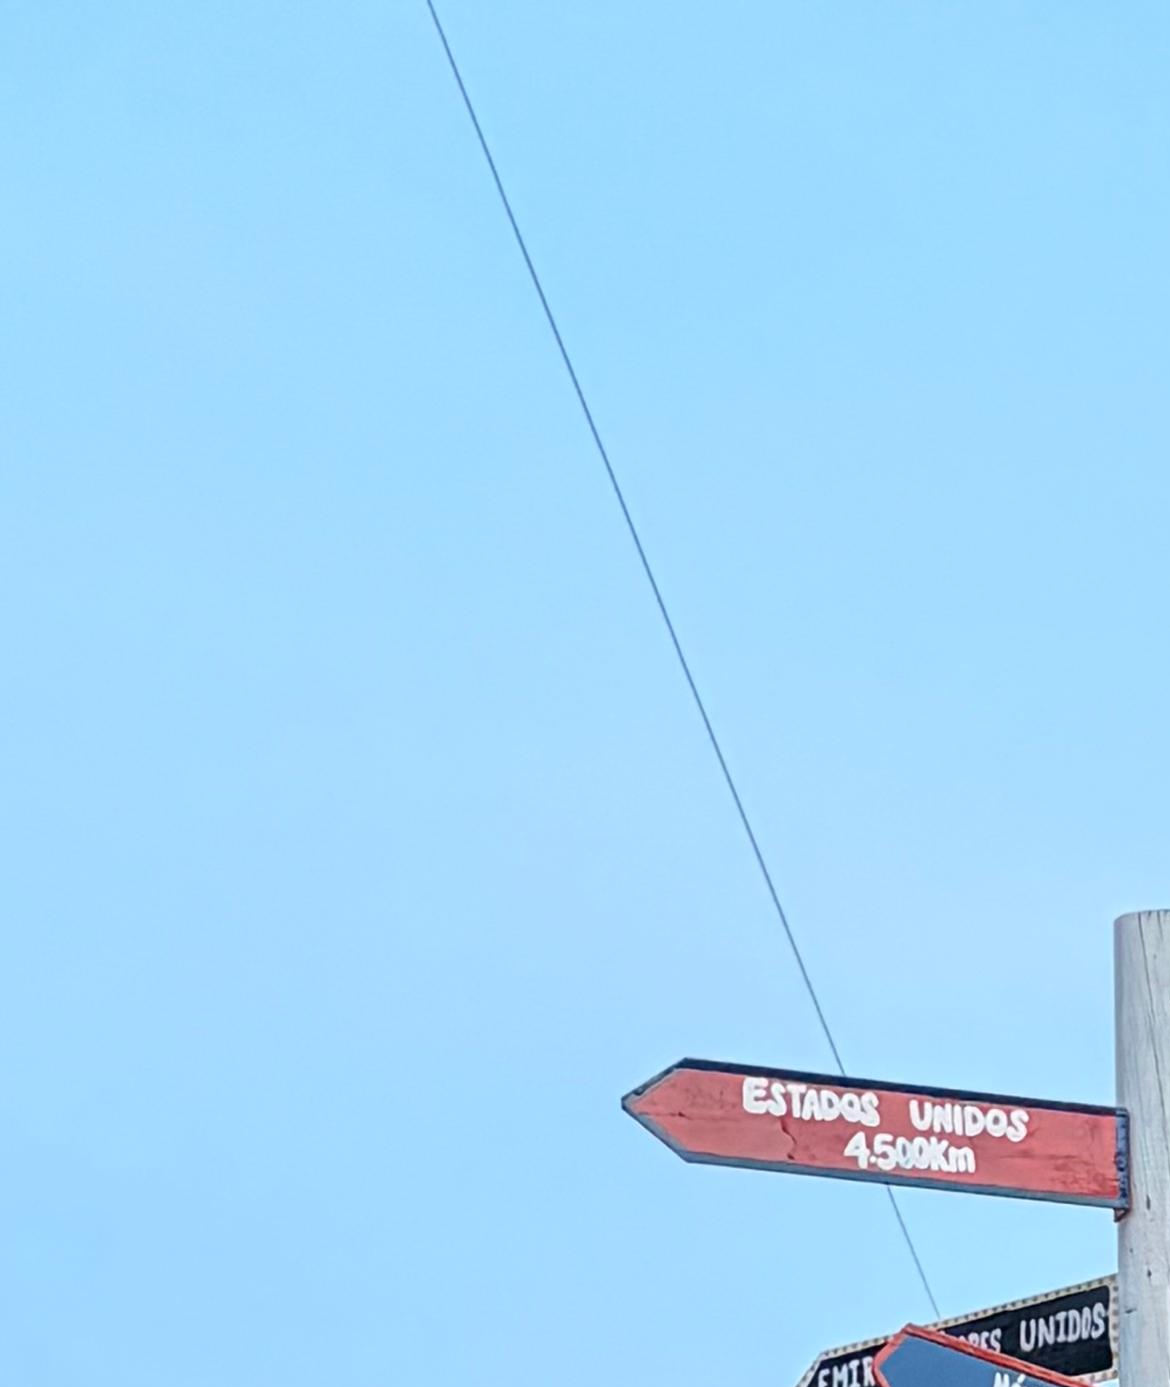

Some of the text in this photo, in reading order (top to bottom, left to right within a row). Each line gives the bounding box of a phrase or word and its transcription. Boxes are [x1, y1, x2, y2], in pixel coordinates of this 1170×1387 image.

[742, 1076, 1030, 1142] ESTADOS UNIDOS
[1019, 1303, 1107, 1352] UNIDOS
